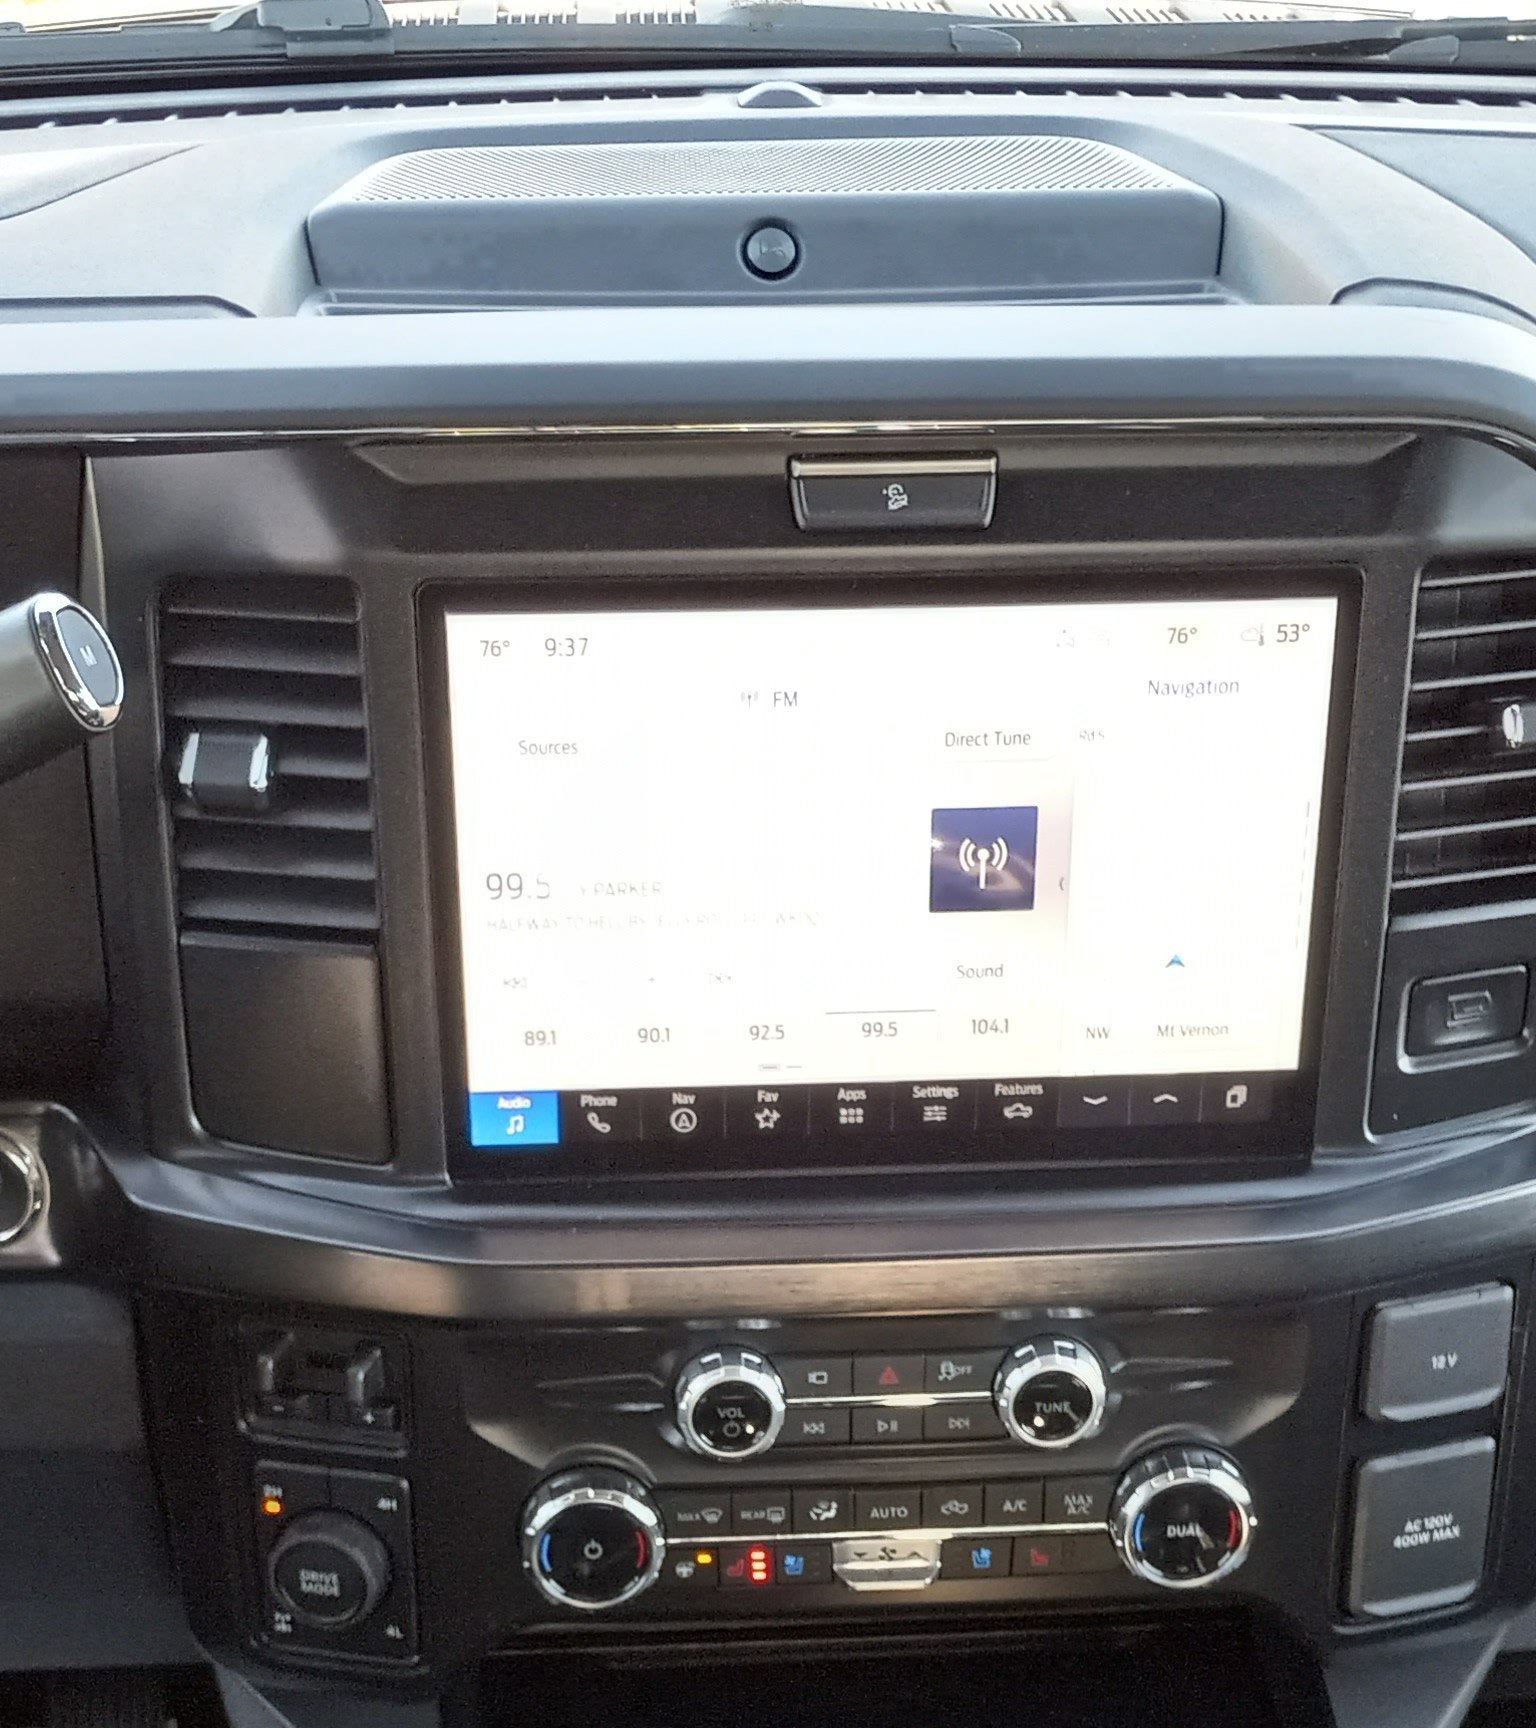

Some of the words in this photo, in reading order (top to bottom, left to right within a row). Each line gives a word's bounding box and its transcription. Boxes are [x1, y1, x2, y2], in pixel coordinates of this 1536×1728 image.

[544, 637, 589, 657] 9:37
[1147, 679, 1240, 698] Navigation
[772, 691, 799, 708] FM
[944, 731, 989, 748] Direct
[994, 730, 1032, 747] Tune
[518, 739, 578, 757] Sources
[485, 872, 551, 900] 99.5
[956, 963, 1004, 979] Sound
[749, 1024, 785, 1041] 92.5
[861, 1021, 898, 1039] 99.5
[971, 1018, 1009, 1035] 104.1
[1085, 1025, 1110, 1040] NW
[524, 1030, 557, 1046] 89.1
[637, 1027, 671, 1043] 90.1
[757, 1089, 779, 1103] Fav
[837, 1087, 867, 1104] Apps
[912, 1084, 959, 1100] Settings
[994, 1081, 1043, 1097] Features
[497, 1095, 531, 1109] Audio
[580, 1093, 618, 1107] Phone
[672, 1091, 695, 1105] Nav
[717, 1407, 745, 1420] VOL
[1035, 1401, 1072, 1413] TUNE
[1003, 1499, 1027, 1513] A/C
[1064, 1494, 1094, 1508] MAX
[740, 1511, 766, 1521] REAR
[871, 1505, 908, 1519] AUTO
[1167, 1524, 1201, 1538] DUAL
